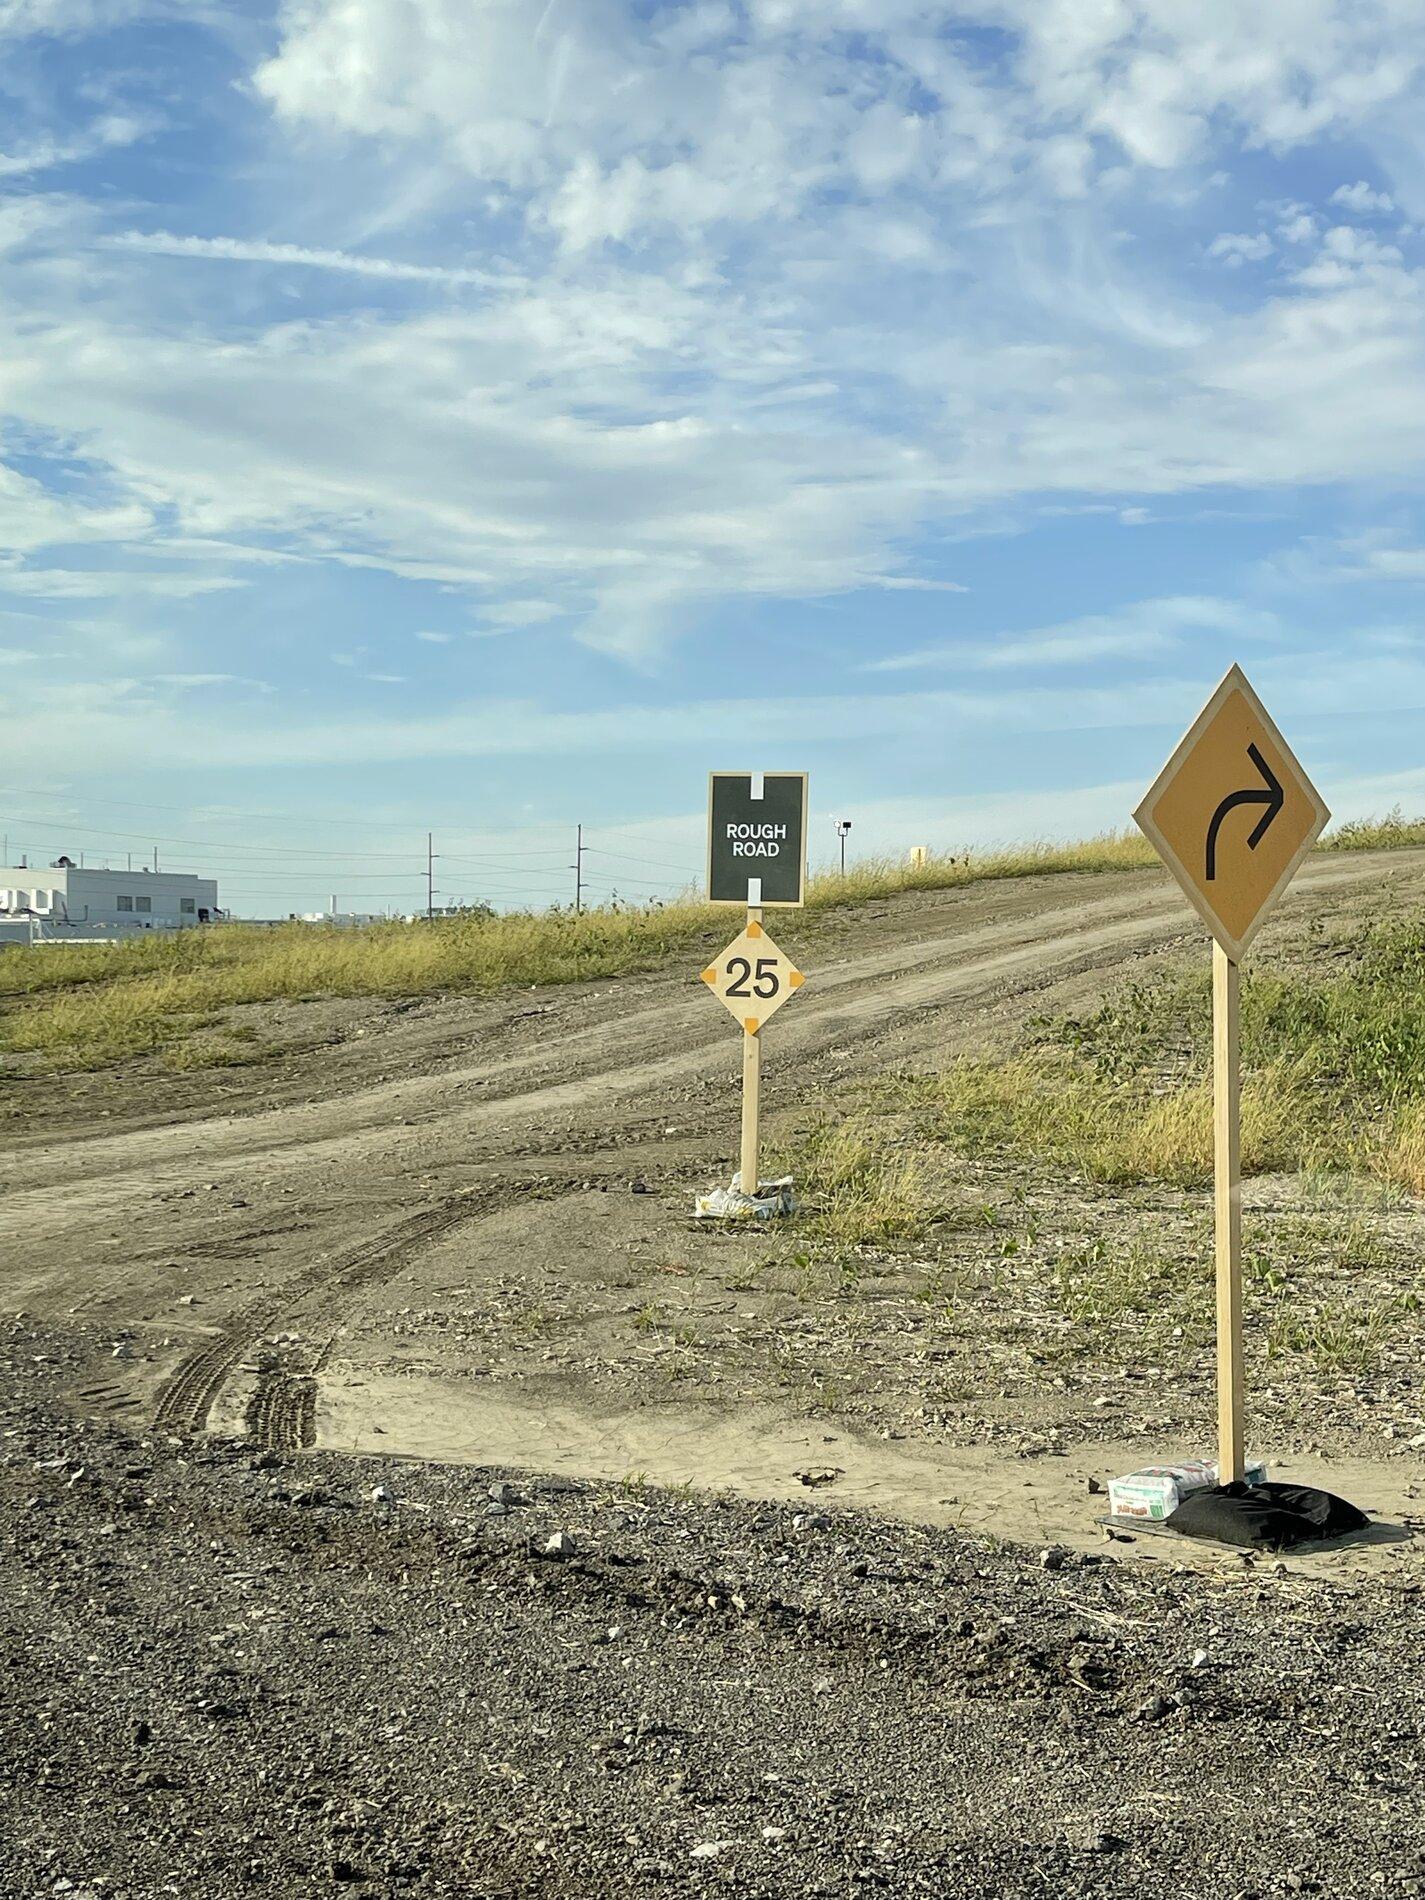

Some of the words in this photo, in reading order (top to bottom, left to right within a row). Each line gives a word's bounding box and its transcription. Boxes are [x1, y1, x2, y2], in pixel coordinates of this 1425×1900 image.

[726, 823, 786, 839] ROUGH
[733, 841, 780, 857] ROAD
[725, 957, 779, 999] 25
